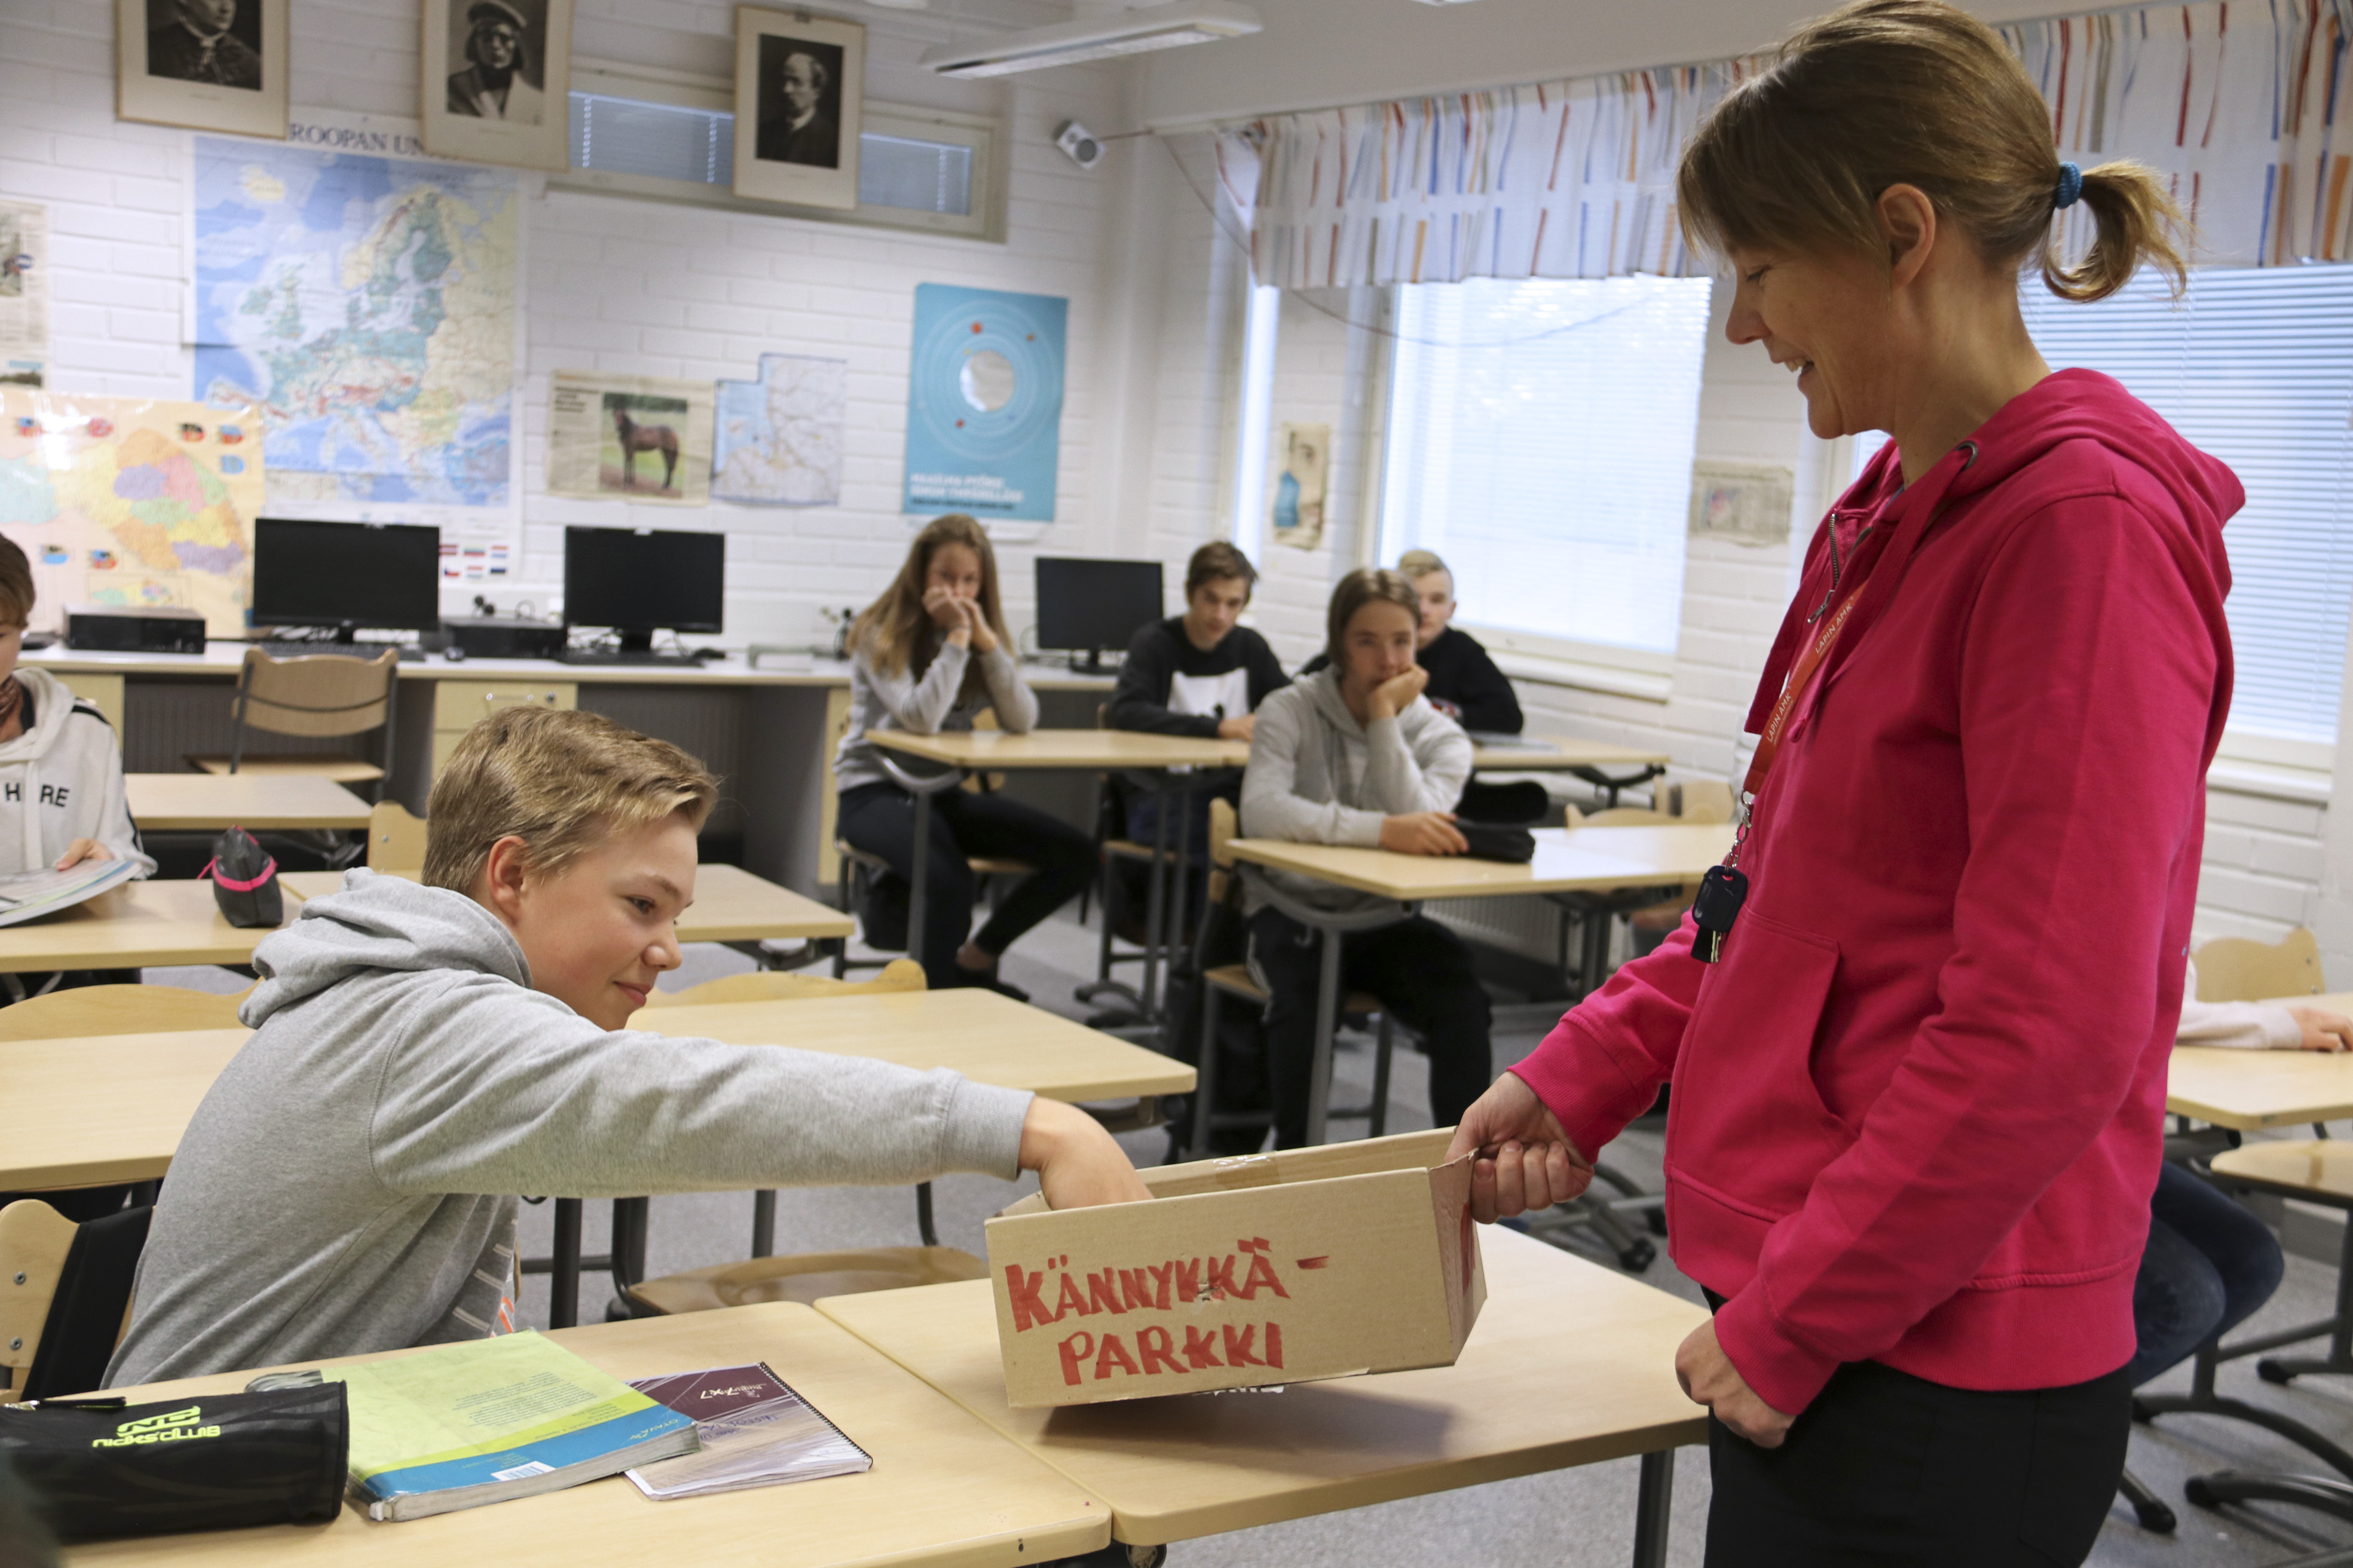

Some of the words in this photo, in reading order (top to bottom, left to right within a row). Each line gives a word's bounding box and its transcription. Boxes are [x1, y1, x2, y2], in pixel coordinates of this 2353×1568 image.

[1815, 625, 1836, 654] LAPIN
[1836, 602, 1853, 627] AMK
[1766, 715, 1781, 743] LAPIN
[1779, 694, 1792, 715] AMK
[1058, 1322, 1284, 1386] PARKKI
